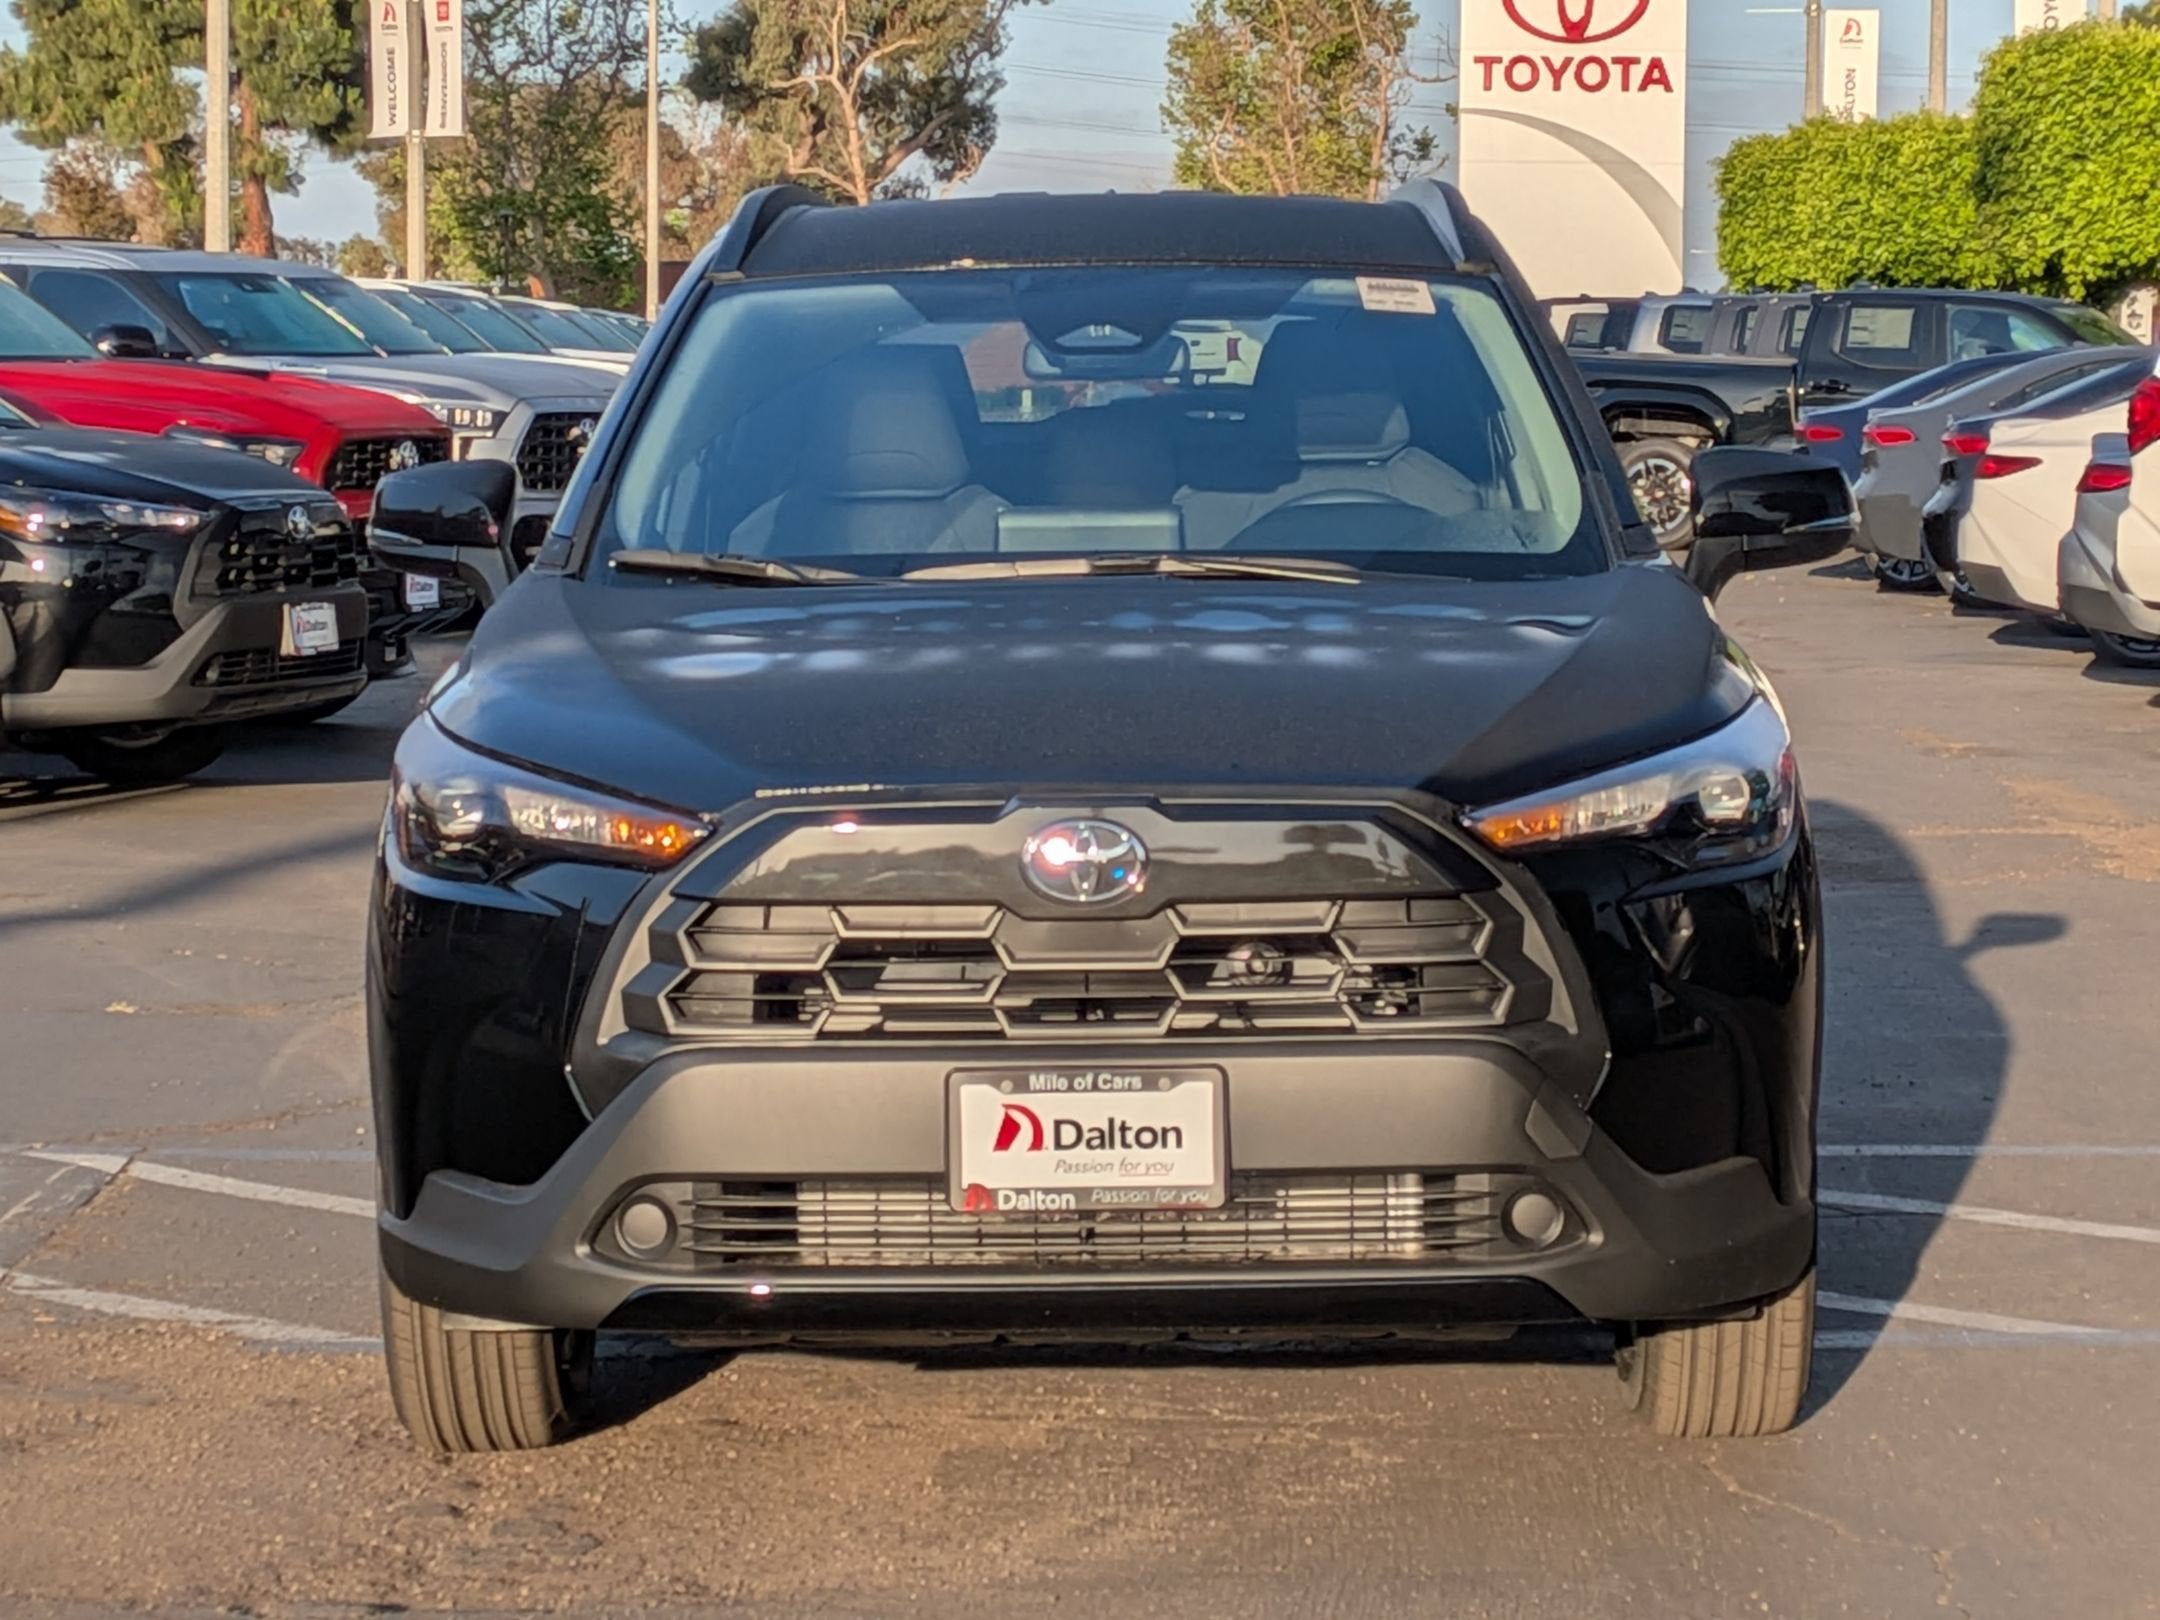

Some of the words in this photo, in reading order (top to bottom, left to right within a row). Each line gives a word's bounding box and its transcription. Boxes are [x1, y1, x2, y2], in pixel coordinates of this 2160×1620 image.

[386, 47, 397, 127] WELCOME
[1473, 55, 1674, 93] TOYOTA
[1844, 67, 1857, 121] ALTON
[1028, 1073, 1068, 1091] Mile
[1073, 1073, 1092, 1090] of
[1097, 1073, 1143, 1091] Cars
[1053, 1117, 1183, 1151] Dalton
[1054, 1158, 1114, 1174] Passion
[1118, 1156, 1141, 1175] for
[1144, 1160, 1175, 1176] you
[997, 1189, 1077, 1211] Dalton
[1091, 1188, 1150, 1204] Passion
[1154, 1188, 1176, 1203] for
[1177, 1191, 1210, 1205] you
